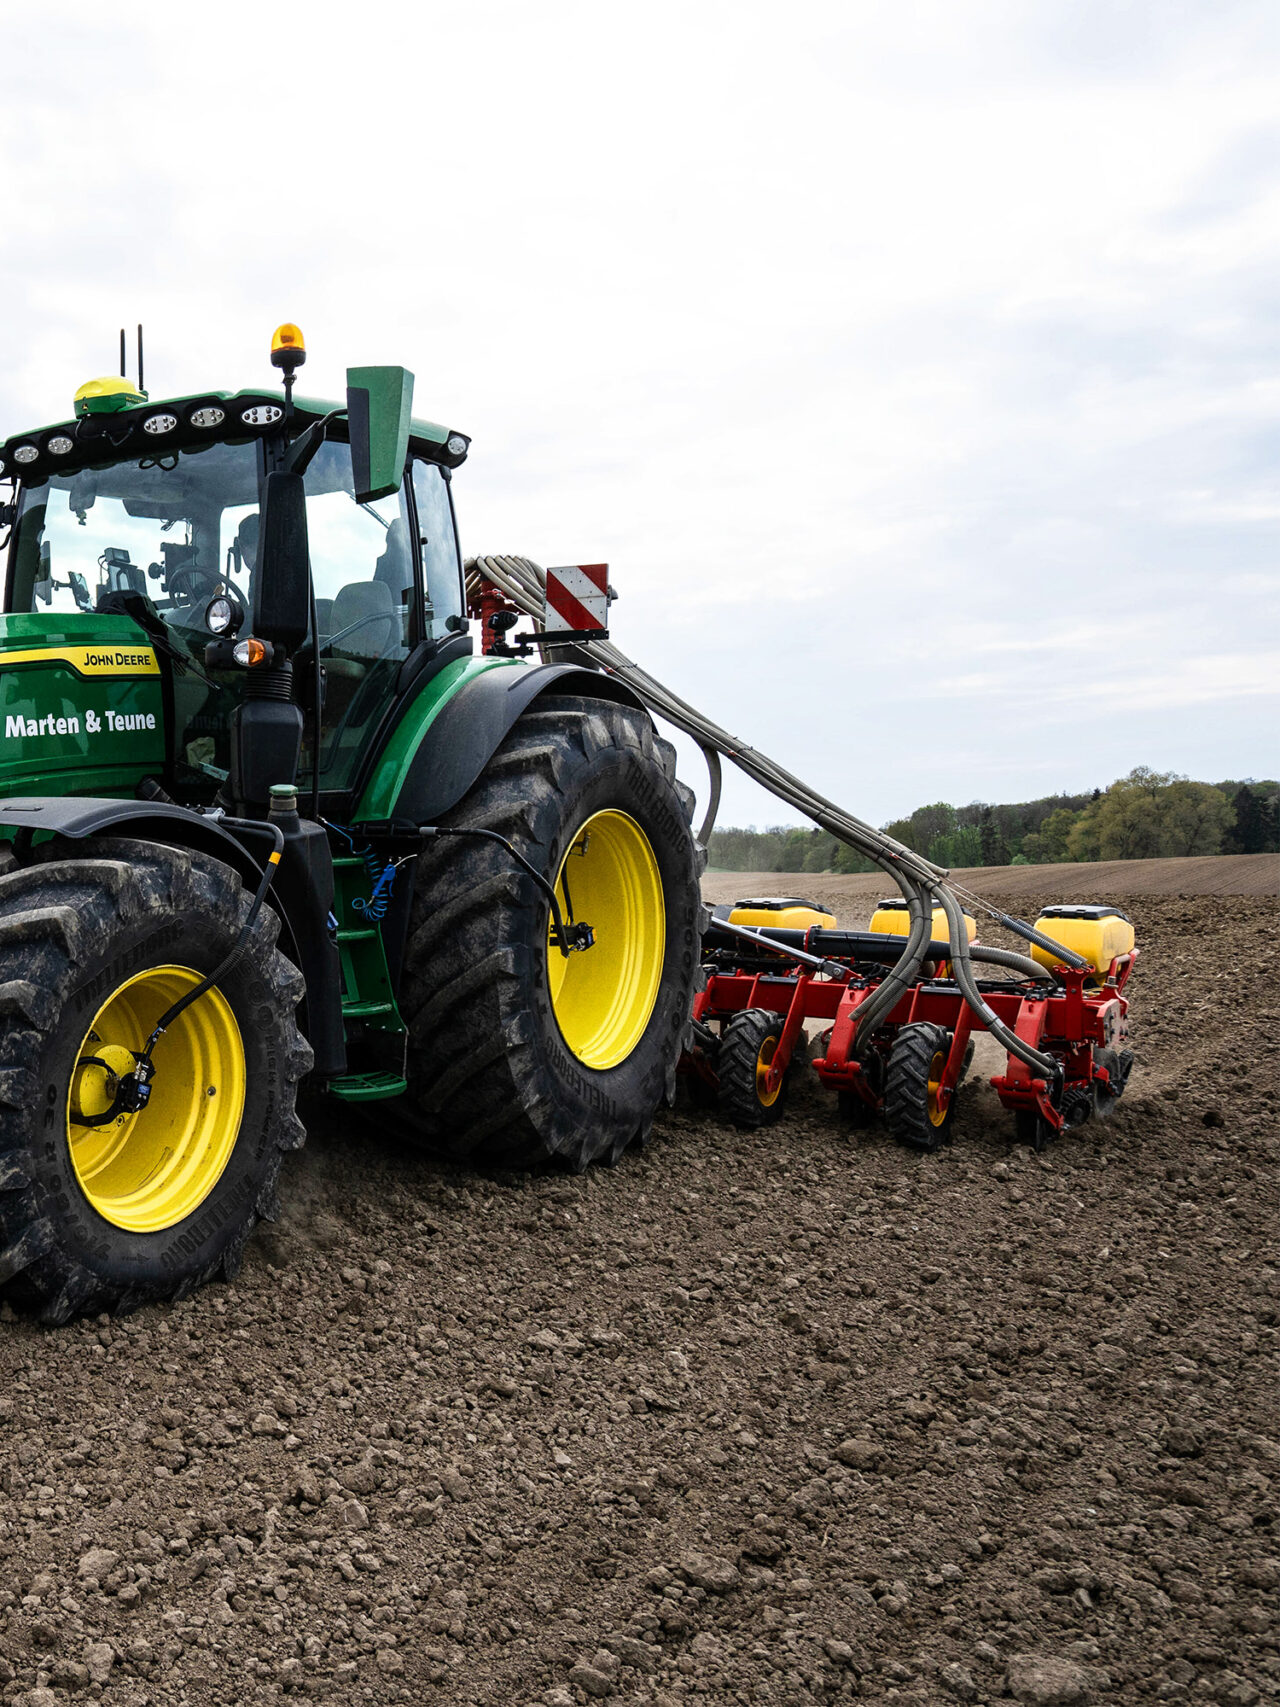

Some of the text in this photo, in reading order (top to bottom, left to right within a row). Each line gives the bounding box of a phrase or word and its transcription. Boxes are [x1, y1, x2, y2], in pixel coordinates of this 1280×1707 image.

[83, 652, 151, 667] JOHN DEERE
[5, 709, 156, 738] Marten & Teune
[624, 758, 690, 854] TRELLEBORG
[545, 1035, 617, 1123] TRELLEBORG
[160, 1173, 260, 1272] TRELLEBORG
